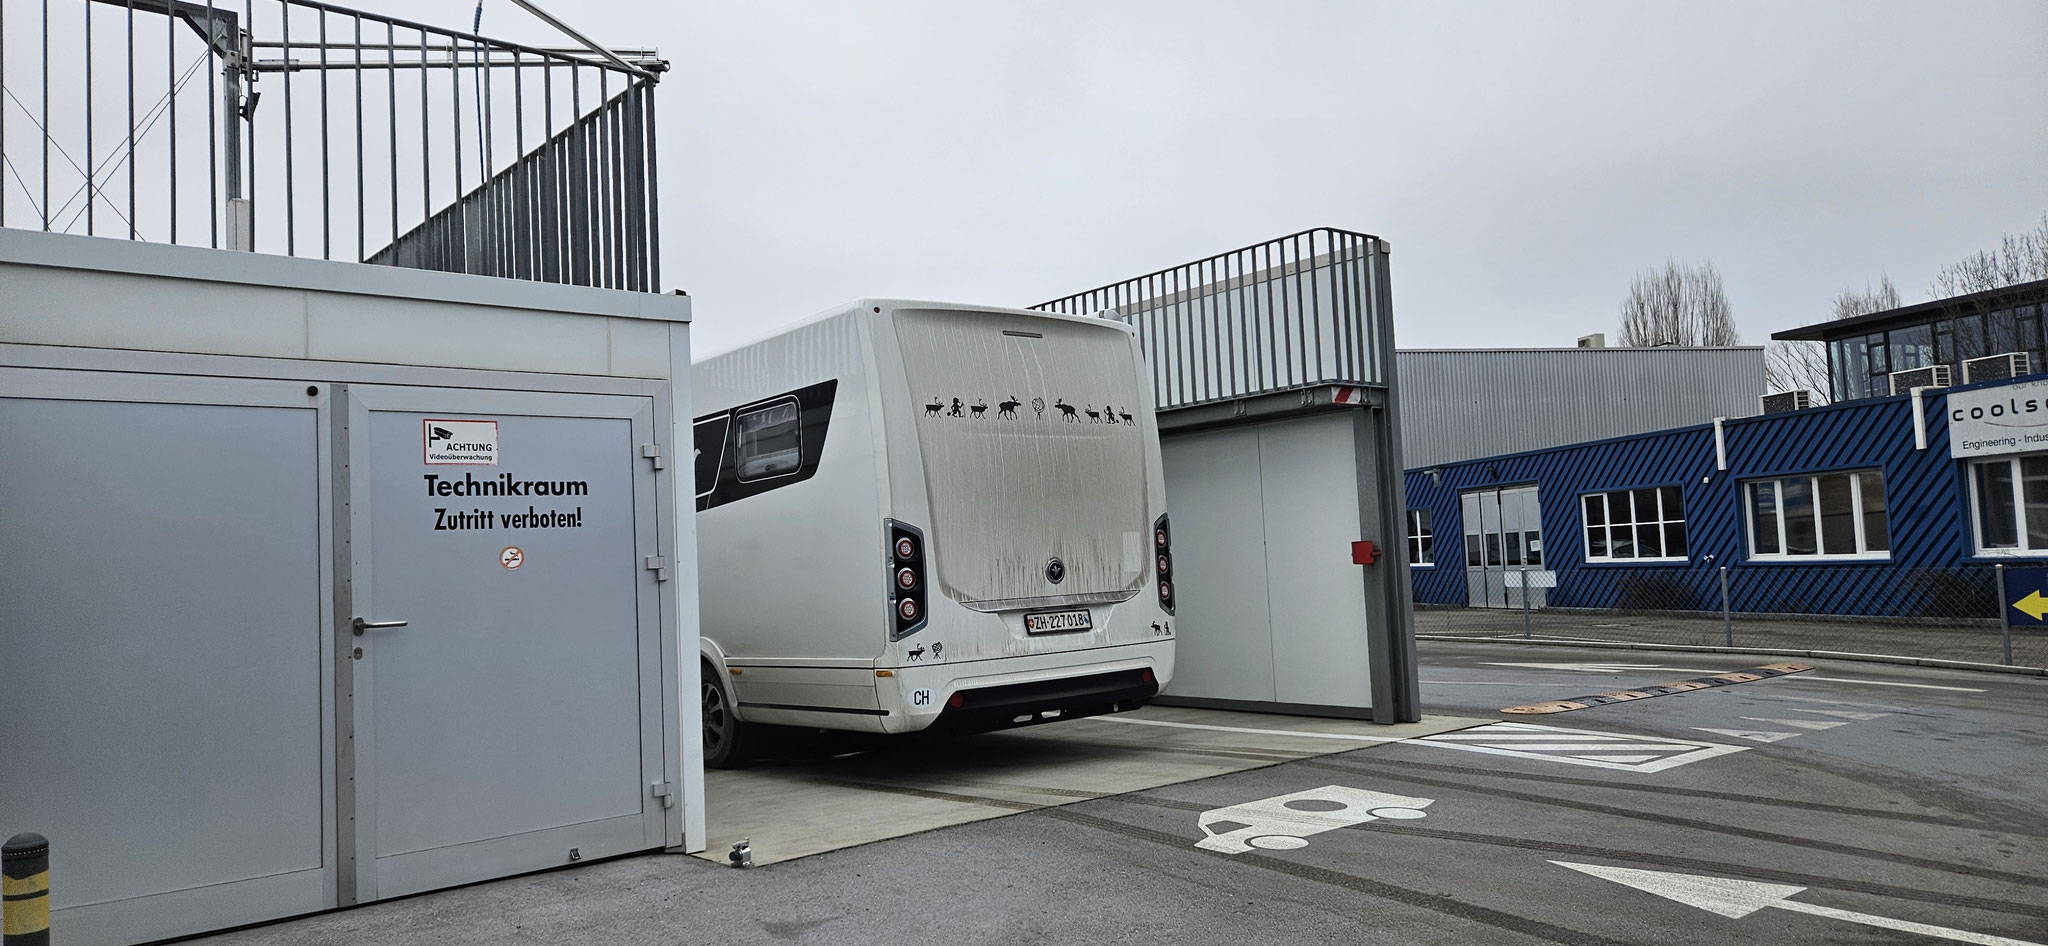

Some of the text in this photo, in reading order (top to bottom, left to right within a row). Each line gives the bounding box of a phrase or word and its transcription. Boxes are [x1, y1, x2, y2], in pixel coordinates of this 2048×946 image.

[1952, 398, 2048, 422] cools
[446, 443, 492, 452] ACHTUNG
[1962, 437, 2016, 451] Engineering
[429, 453, 493, 462] Videoüberwachung
[424, 473, 588, 497] Technikraum
[434, 505, 582, 531] Zutritt verboten!
[914, 689, 930, 706] CH
